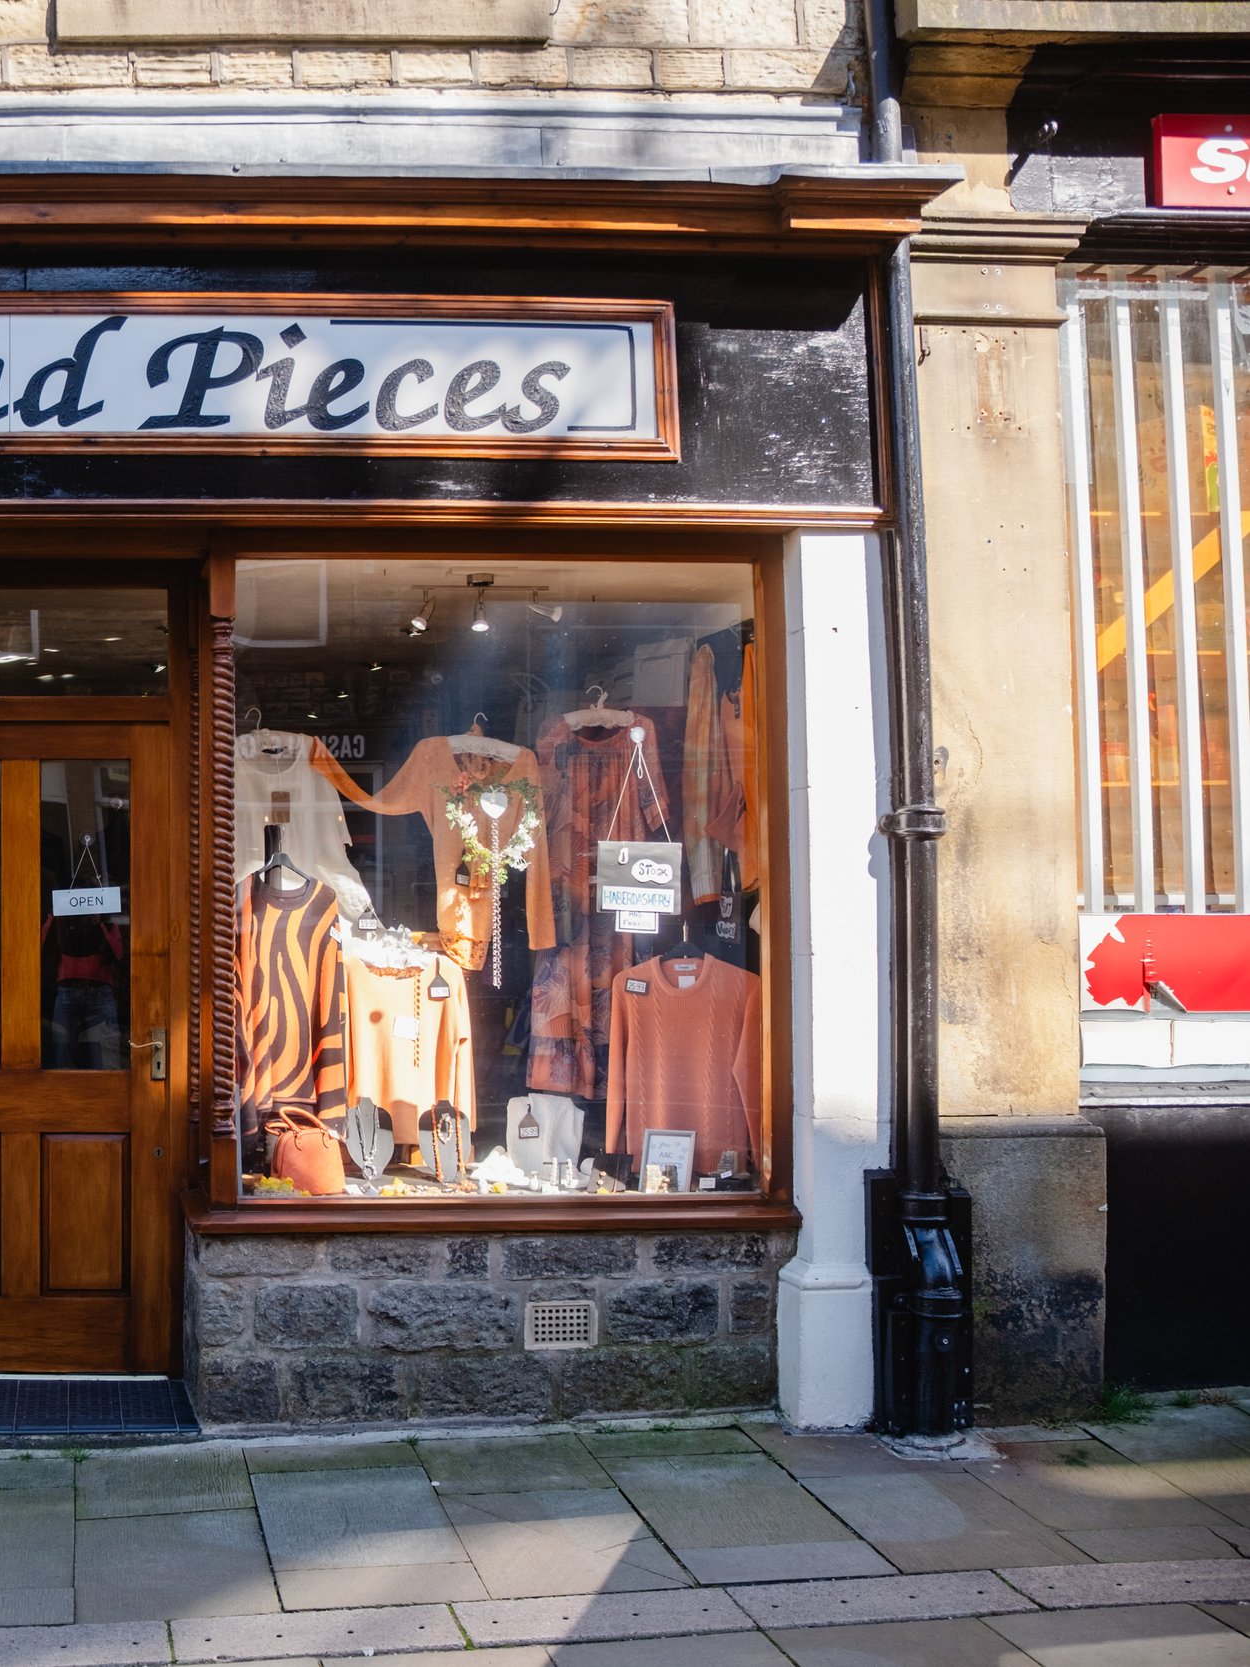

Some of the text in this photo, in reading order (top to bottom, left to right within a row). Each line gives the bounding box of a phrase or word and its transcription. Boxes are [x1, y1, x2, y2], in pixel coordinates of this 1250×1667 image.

[1190, 136, 1250, 184] S
[137, 323, 572, 434] Pieces
[69, 896, 104, 908] OPEN
[603, 889, 671, 908] HABERDASHERY
